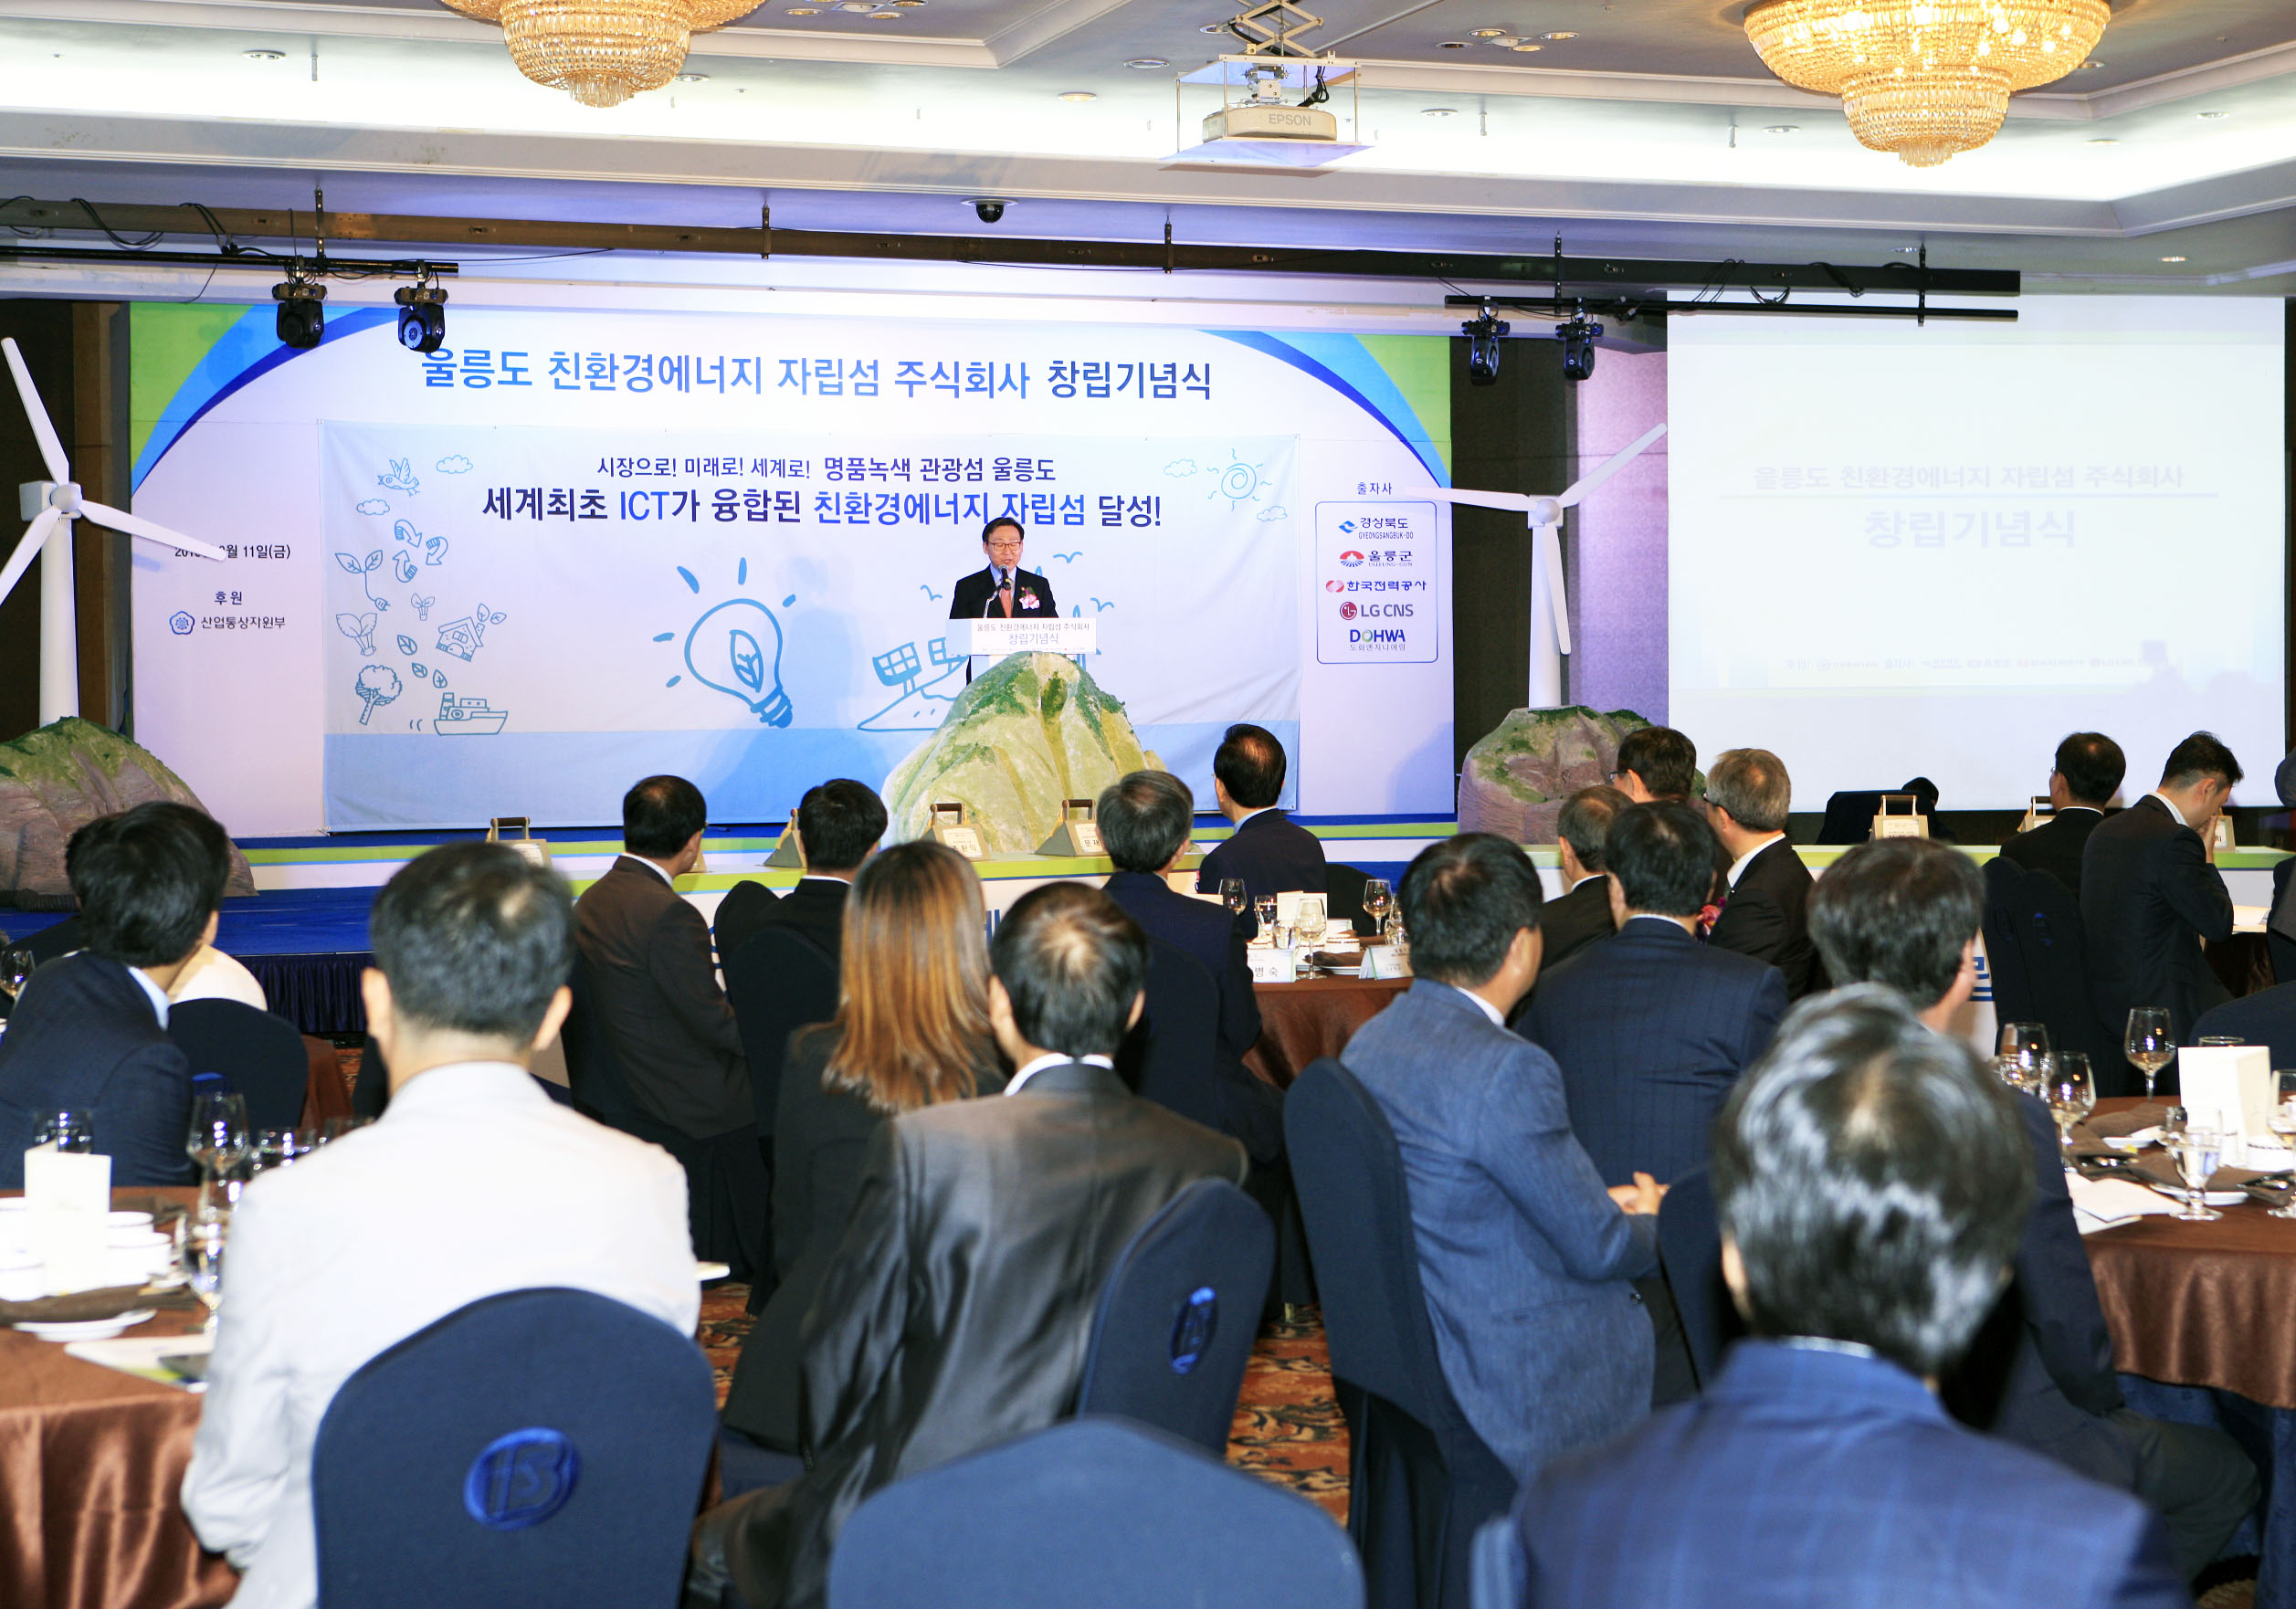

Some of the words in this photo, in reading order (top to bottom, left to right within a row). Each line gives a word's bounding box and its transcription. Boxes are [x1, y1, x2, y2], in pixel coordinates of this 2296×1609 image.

[1269, 113, 1311, 126] EPSON
[421, 348, 533, 389] 울릉도
[548, 352, 763, 395] 친환경에너지
[777, 357, 879, 397] 자립섬
[894, 360, 1031, 399] 주식회사
[1048, 360, 1211, 400] 창립기념식
[596, 457, 677, 478] 시장으로!
[685, 457, 744, 478] 미래로!
[750, 458, 811, 479] 세계로!
[824, 457, 911, 482] 명품녹색
[919, 457, 984, 482] 관광섬
[992, 457, 1057, 482] 울릉도
[1753, 466, 1831, 489] 울릉도
[1839, 466, 1991, 489] 친환경에너지
[2000, 466, 2076, 489] 자립섬
[2084, 466, 2185, 489] 주식회사
[1357, 482, 1392, 495] 출자사
[482, 487, 608, 521] 세계최초
[620, 489, 700, 522] ICT가
[711, 489, 801, 523] 융합된
[813, 491, 989, 526] 친환경에너지
[1000, 492, 1085, 526] 자립섬
[1098, 495, 1162, 528] 달성!
[1360, 517, 1409, 529] 경상북도
[1864, 510, 2077, 549] 창립기념식
[1358, 531, 1414, 540] GYEONGSANGBUK-DO
[243, 544, 291, 560] 11일(금)
[1367, 550, 1413, 562] 울릉군
[1347, 581, 1427, 592] 한국전력공사
[1361, 604, 1380, 617] LG
[1383, 604, 1414, 617] CNS
[201, 616, 286, 629] 산업통상자원부
[1008, 633, 1059, 645] 창립기념식
[1350, 629, 1406, 643] DOHWA
